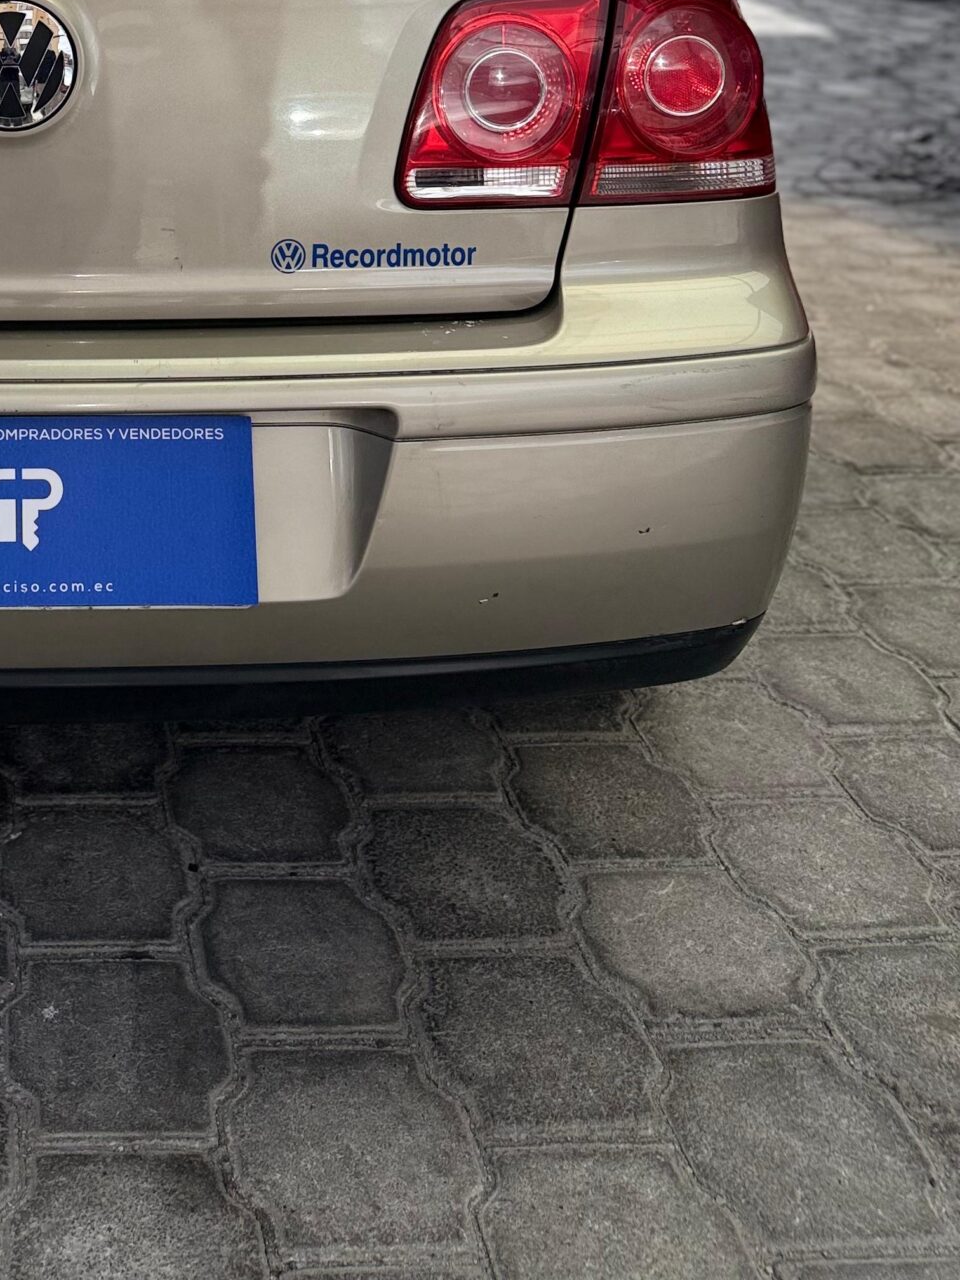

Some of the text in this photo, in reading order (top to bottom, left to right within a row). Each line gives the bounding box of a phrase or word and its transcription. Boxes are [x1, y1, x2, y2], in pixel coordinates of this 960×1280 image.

[312, 243, 477, 268] Recordmotor
[105, 428, 116, 440] Y
[118, 428, 224, 440] VENDEDORES
